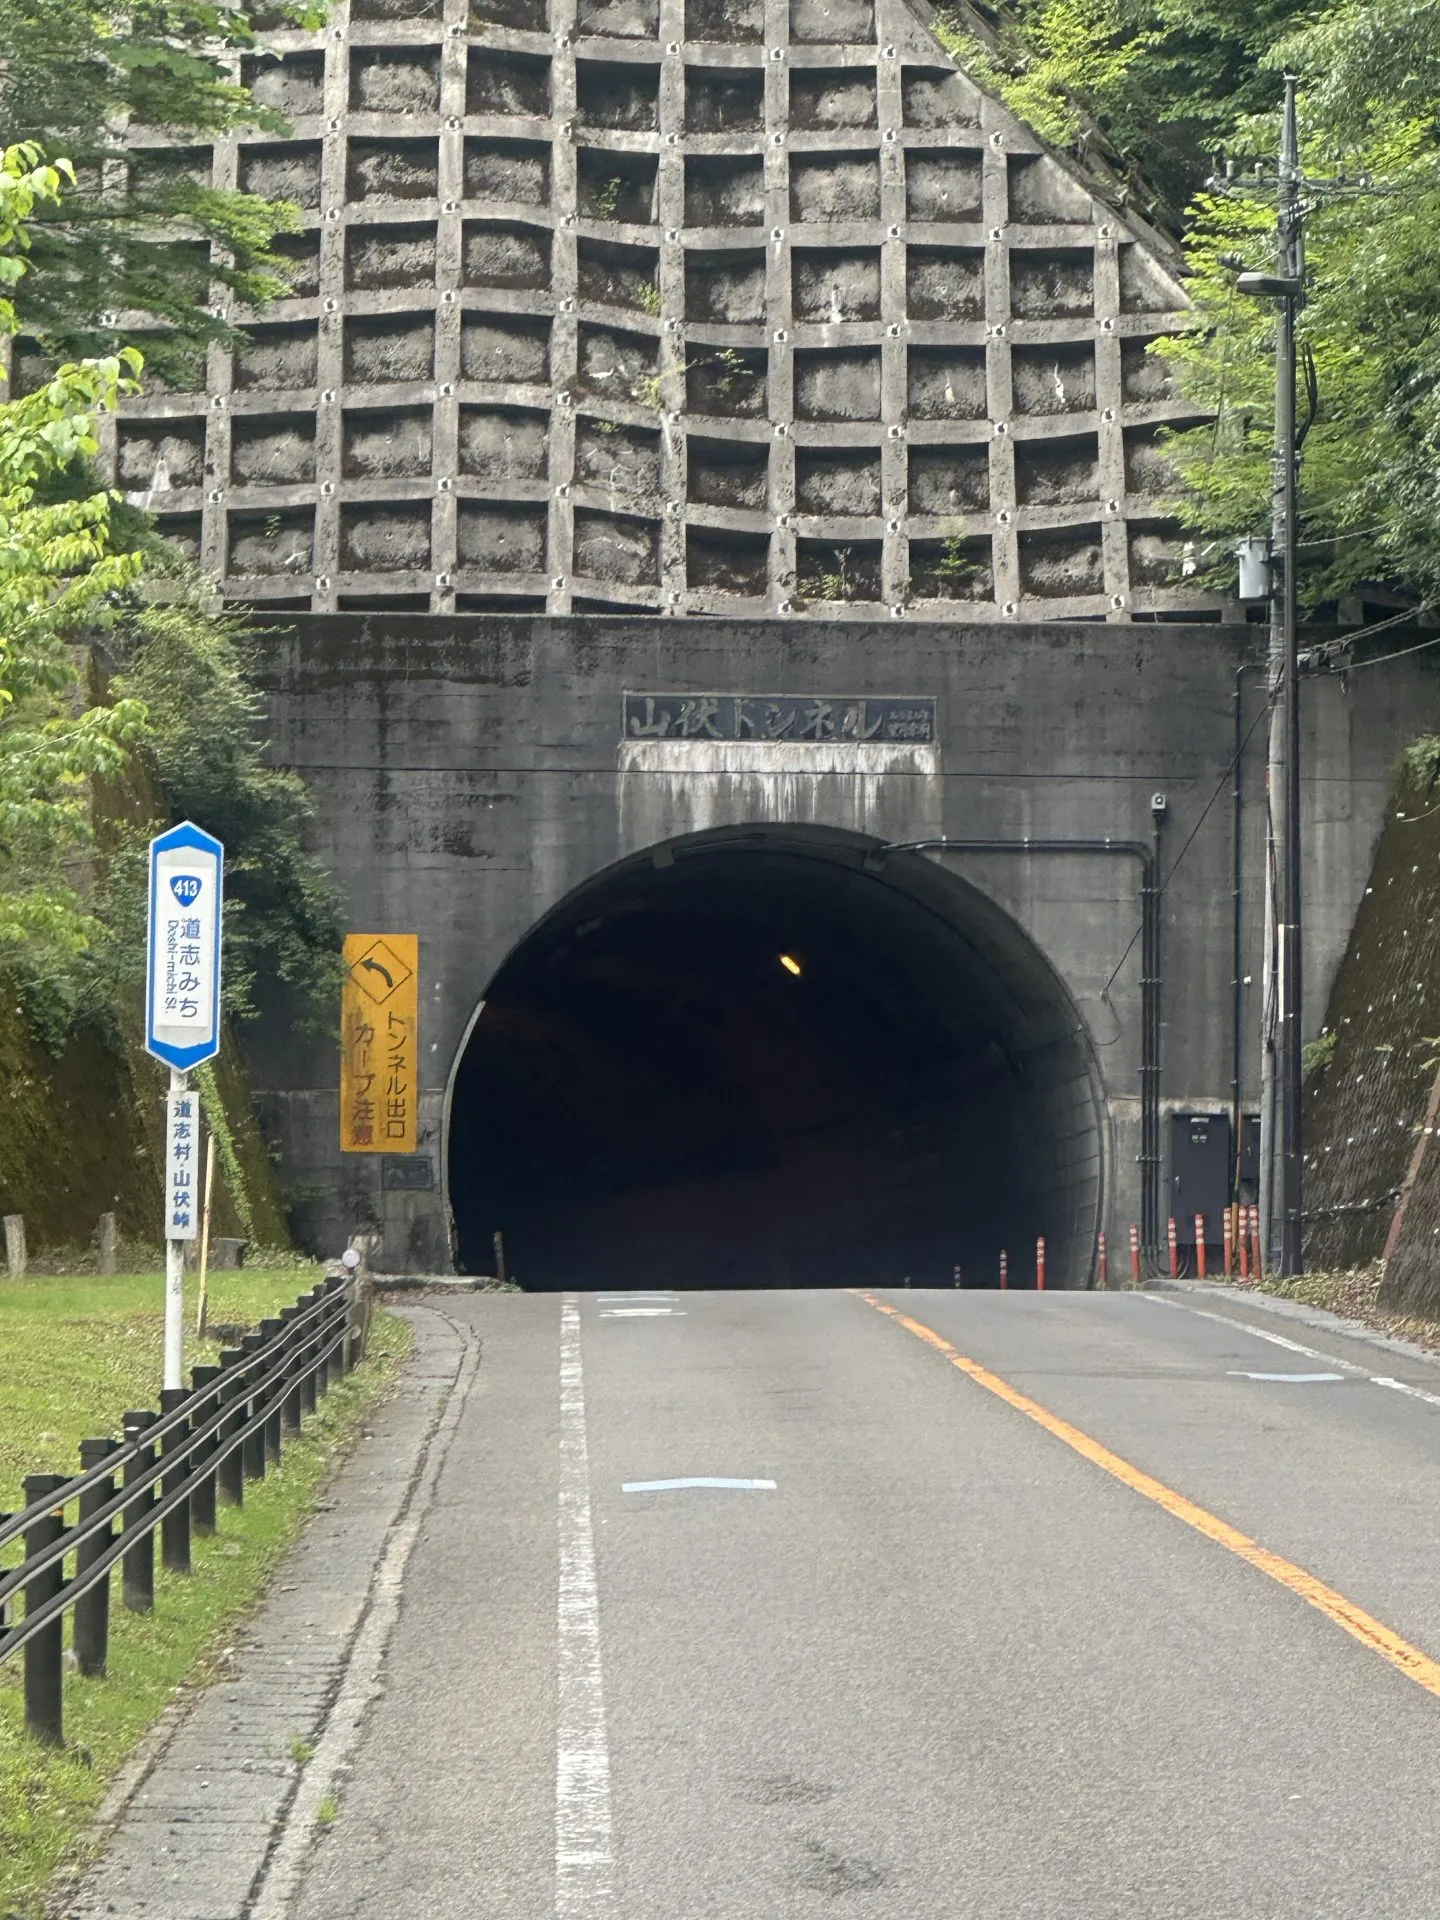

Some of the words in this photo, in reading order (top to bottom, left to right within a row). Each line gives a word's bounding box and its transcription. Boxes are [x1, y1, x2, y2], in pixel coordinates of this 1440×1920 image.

[630, 697, 882, 740] 山伏トンネル
[174, 880, 198, 897] 413
[180, 918, 201, 1018] 道志みち
[387, 1012, 407, 1138] トンネル出口
